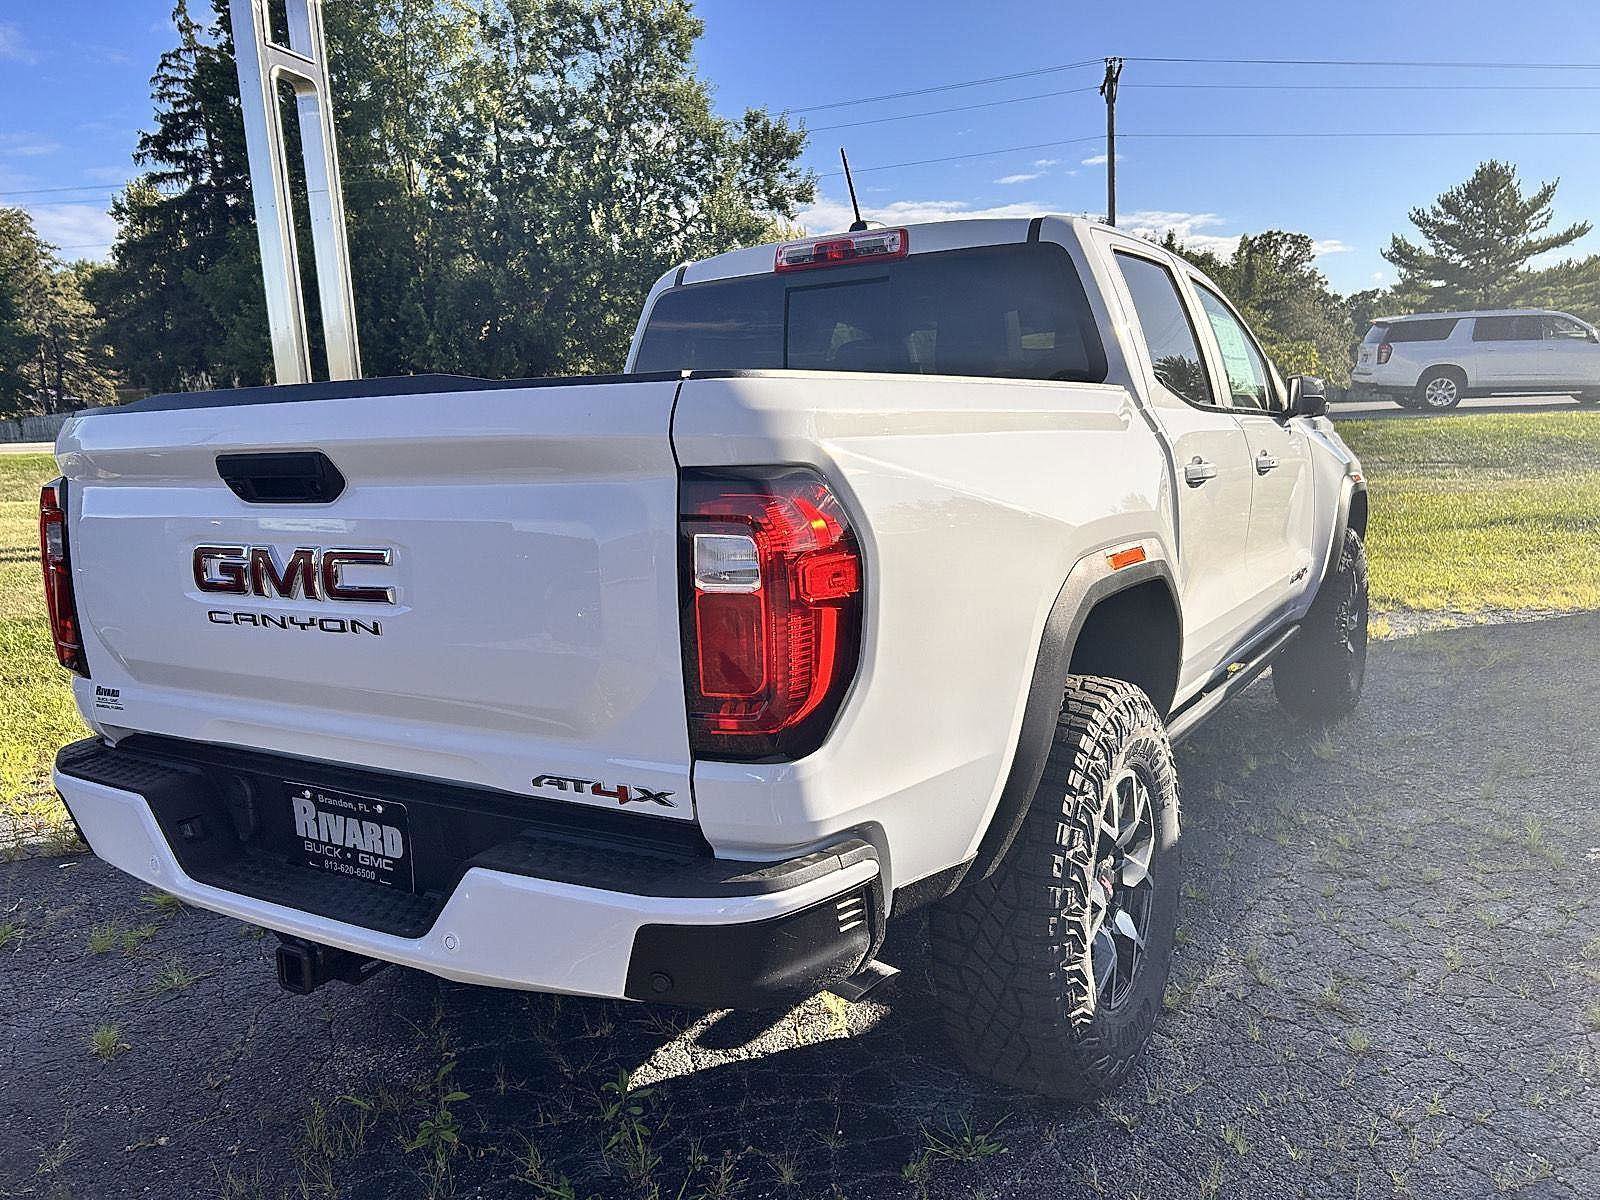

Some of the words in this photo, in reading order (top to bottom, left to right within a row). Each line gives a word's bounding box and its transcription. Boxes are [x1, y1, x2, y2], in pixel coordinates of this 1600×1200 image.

[192, 544, 396, 605] GMC
[207, 610, 383, 636] CANYON
[95, 685, 120, 698] RIVARD
[317, 793, 357, 812] Brandon,
[358, 802, 371, 813] FL
[531, 774, 679, 809] AT4X
[291, 796, 404, 860] RIVARD
[304, 840, 343, 859] BUICK
[358, 852, 394, 872] GMC
[324, 859, 376, 880] 813-620-6500
